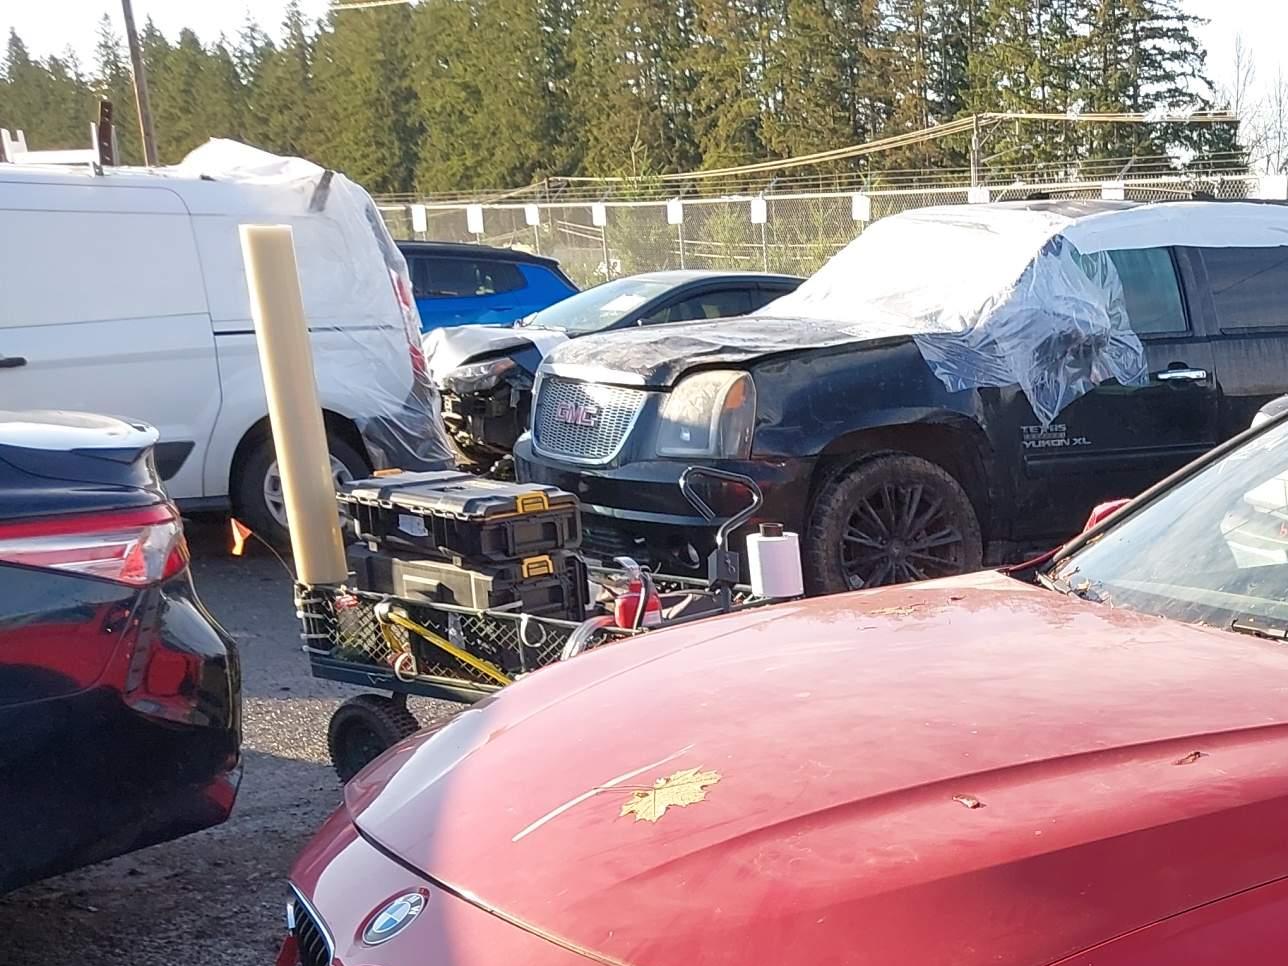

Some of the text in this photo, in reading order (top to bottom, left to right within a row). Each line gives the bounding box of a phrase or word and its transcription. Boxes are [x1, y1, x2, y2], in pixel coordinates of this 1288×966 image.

[557, 401, 598, 427] GMC
[1022, 437, 1092, 448] YUKON XL
